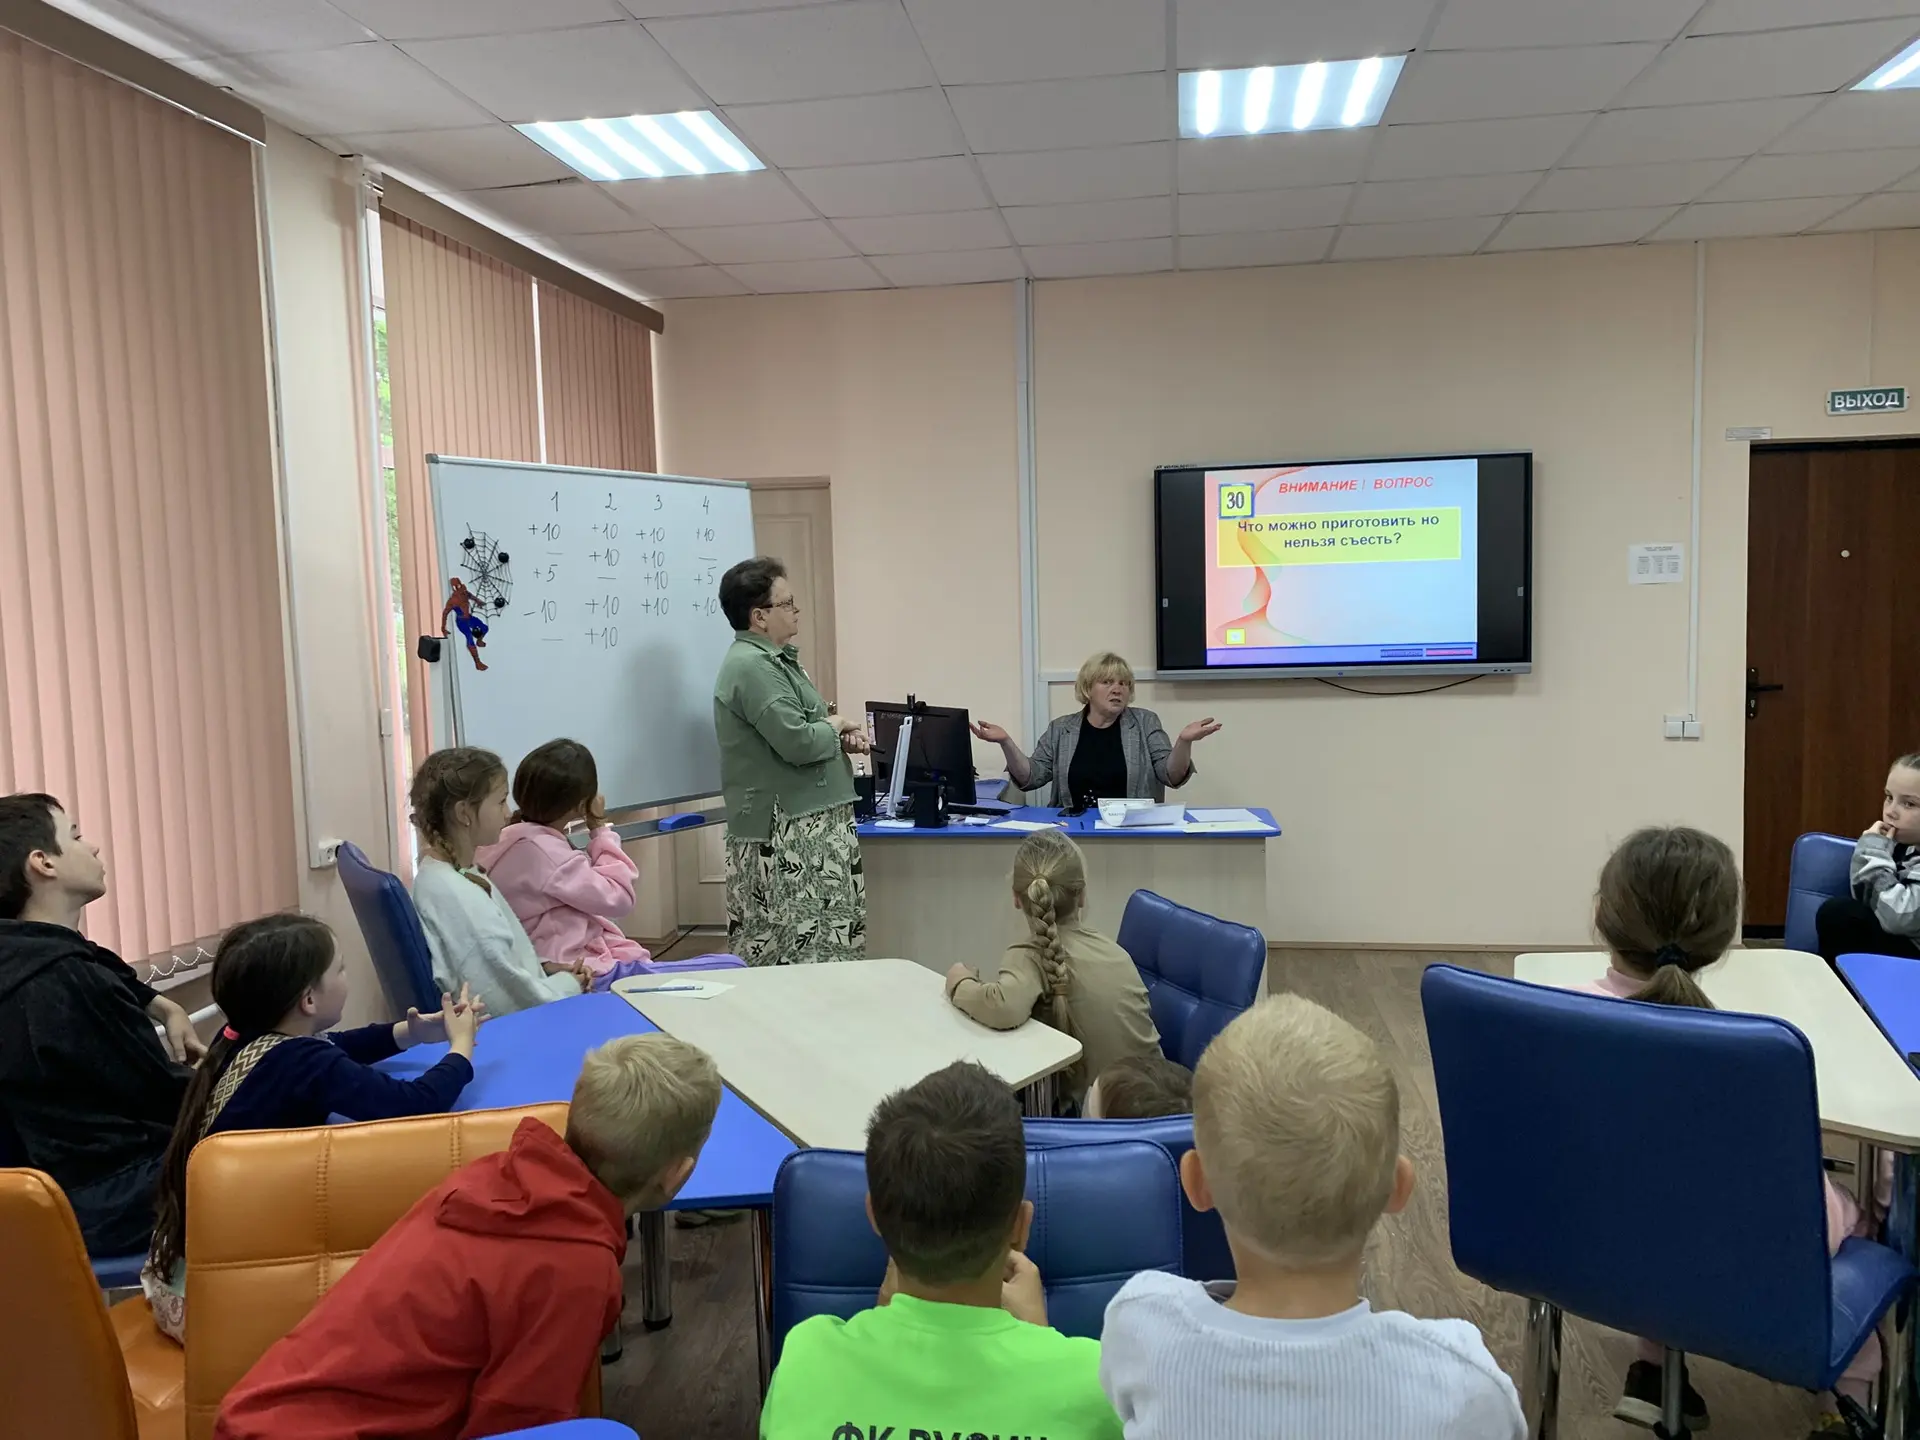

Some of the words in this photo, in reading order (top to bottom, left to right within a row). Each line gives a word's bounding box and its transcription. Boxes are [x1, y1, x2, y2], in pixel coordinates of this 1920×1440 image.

[1834, 391, 1900, 408] ВЫХОД
[1373, 476, 1434, 490] ВОПРОС
[550, 491, 559, 512] 1
[604, 492, 618, 511] 2
[653, 494, 663, 511] 3
[702, 495, 710, 515] 4
[1226, 491, 1245, 510] 30
[1238, 521, 1264, 532] Что
[1268, 520, 1317, 531] можно
[1321, 517, 1416, 531] приготовить
[1421, 515, 1440, 525] но
[1284, 537, 1336, 548] нельзя
[1340, 532, 1402, 546] съесть?
